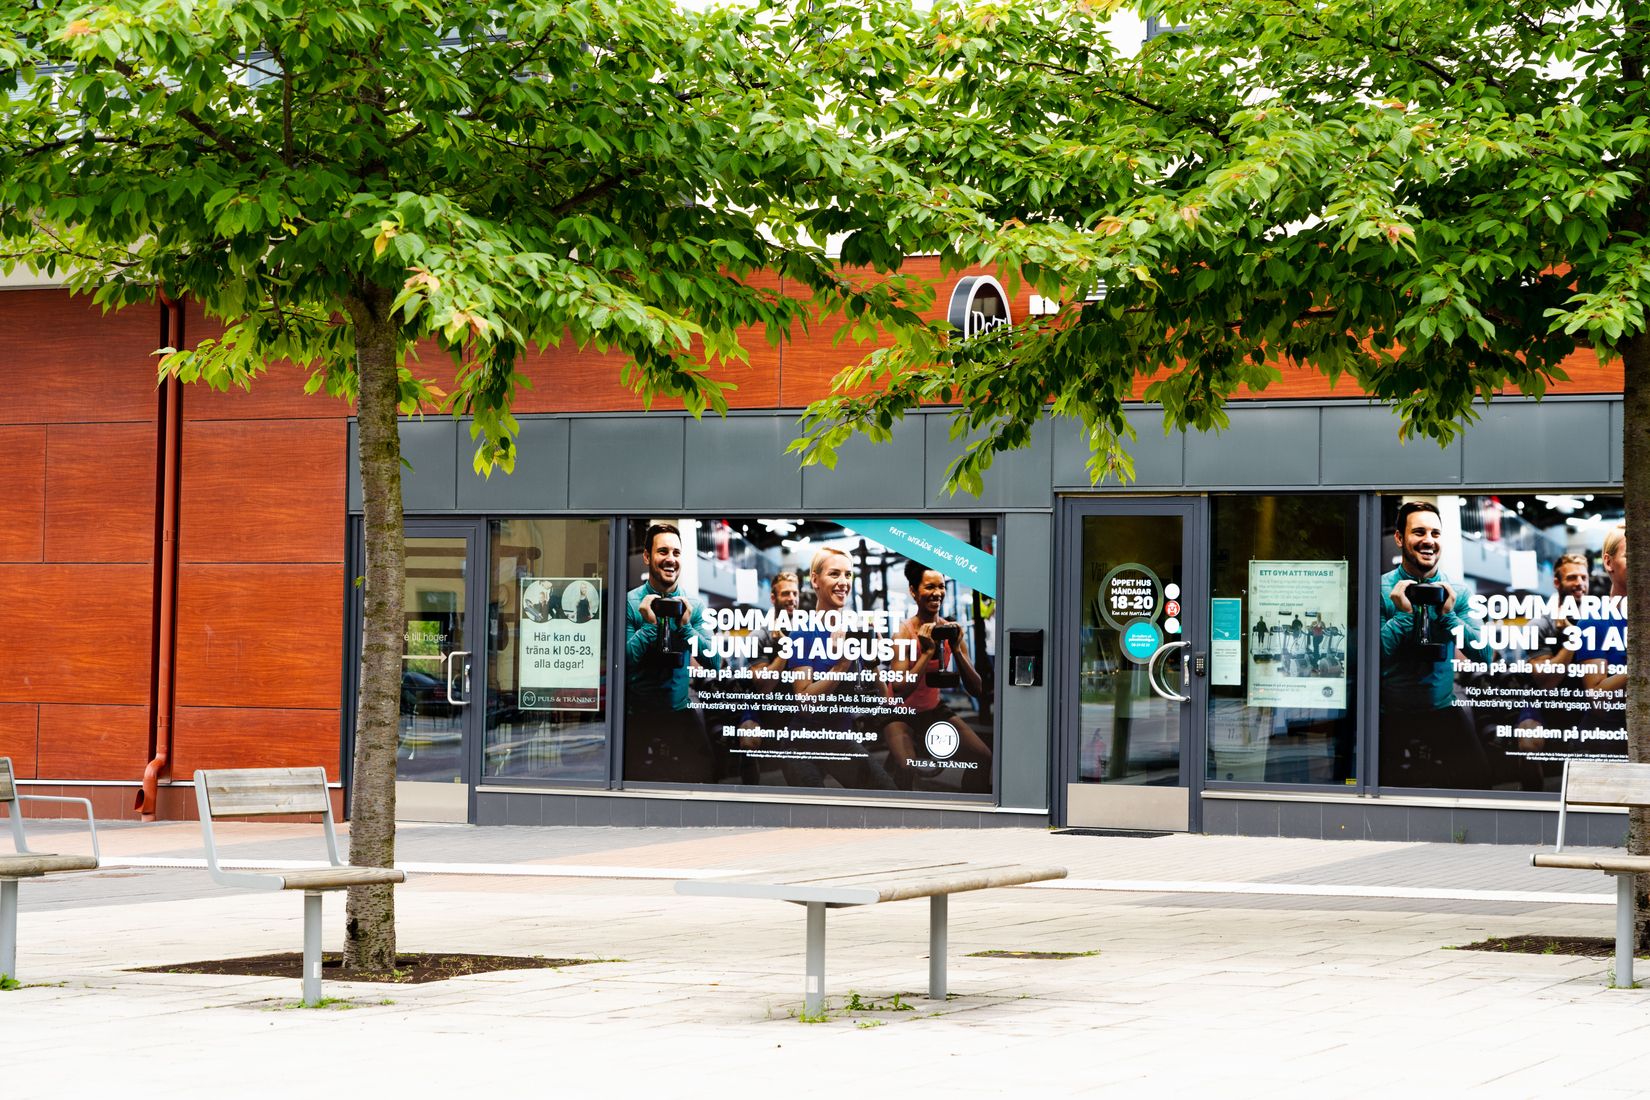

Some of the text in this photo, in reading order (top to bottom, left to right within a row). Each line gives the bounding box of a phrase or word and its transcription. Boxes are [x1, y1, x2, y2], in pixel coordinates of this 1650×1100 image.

[954, 555, 969, 568] 400
[1111, 577, 1152, 587] ÖPPET HUS
[1111, 587, 1151, 595] MÅNDAGAR
[1110, 595, 1154, 610] 18-20
[702, 608, 906, 633] SOMMARKORTET
[411, 632, 421, 641] till
[423, 632, 448, 643] höger
[534, 632, 586, 642] Här kan du
[1450, 625, 1464, 650] 1
[1469, 625, 1539, 650] JUNI
[1545, 637, 1557, 645] -
[1562, 626, 1596, 651] 31
[526, 645, 594, 657] träna kl 05-23,
[687, 636, 698, 657] 1
[703, 636, 759, 659] JUNI
[777, 637, 804, 660] 31
[808, 638, 917, 662] AUGUSTI
[534, 659, 584, 671] alla dagar!
[1450, 659, 1488, 673] Träna
[1490, 659, 1507, 676] på
[1509, 659, 1533, 674] alla
[1535, 660, 1566, 674] våra
[1568, 663, 1598, 678] gym
[1600, 661, 1605, 674] i
[687, 666, 917, 683] Träna på alla våra gym i sommar för 895 kr
[698, 691, 711, 700] Köp
[712, 691, 725, 699] vårt
[726, 692, 764, 700] sommarkort
[765, 692, 774, 700] så
[774, 692, 784, 701] får
[785, 692, 794, 701] du
[794, 693, 817, 703] tillgång
[826, 694, 838, 702] alla
[838, 694, 852, 702] Puls
[853, 694, 860, 702] &
[860, 694, 887, 704] Tränings
[888, 697, 904, 706] gym,
[1465, 686, 1481, 697] Köp
[1482, 686, 1499, 696] vårt
[1500, 687, 1548, 696] sommarkort
[1549, 687, 1559, 697] så
[1560, 687, 1572, 697] får
[1573, 688, 1584, 697] du
[1585, 688, 1613, 700] tillgång
[1614, 689, 1624, 698] till
[686, 702, 917, 716] utomhusträning och vår träningsapp. Vi bjuder på inträdesavgiften 400 kr.
[1451, 698, 1512, 710] utomhusträning
[1514, 700, 1528, 708] och
[1530, 699, 1543, 708] vår
[1544, 700, 1592, 712] träningsapp.
[1593, 701, 1602, 710] Vi
[722, 725, 878, 744] Bli medlem på pulsochtraning.se
[1496, 725, 1628, 743] Bli medlem på pulsoch
[906, 758, 928, 767] PULS
[937, 760, 978, 769] TRÄNING
